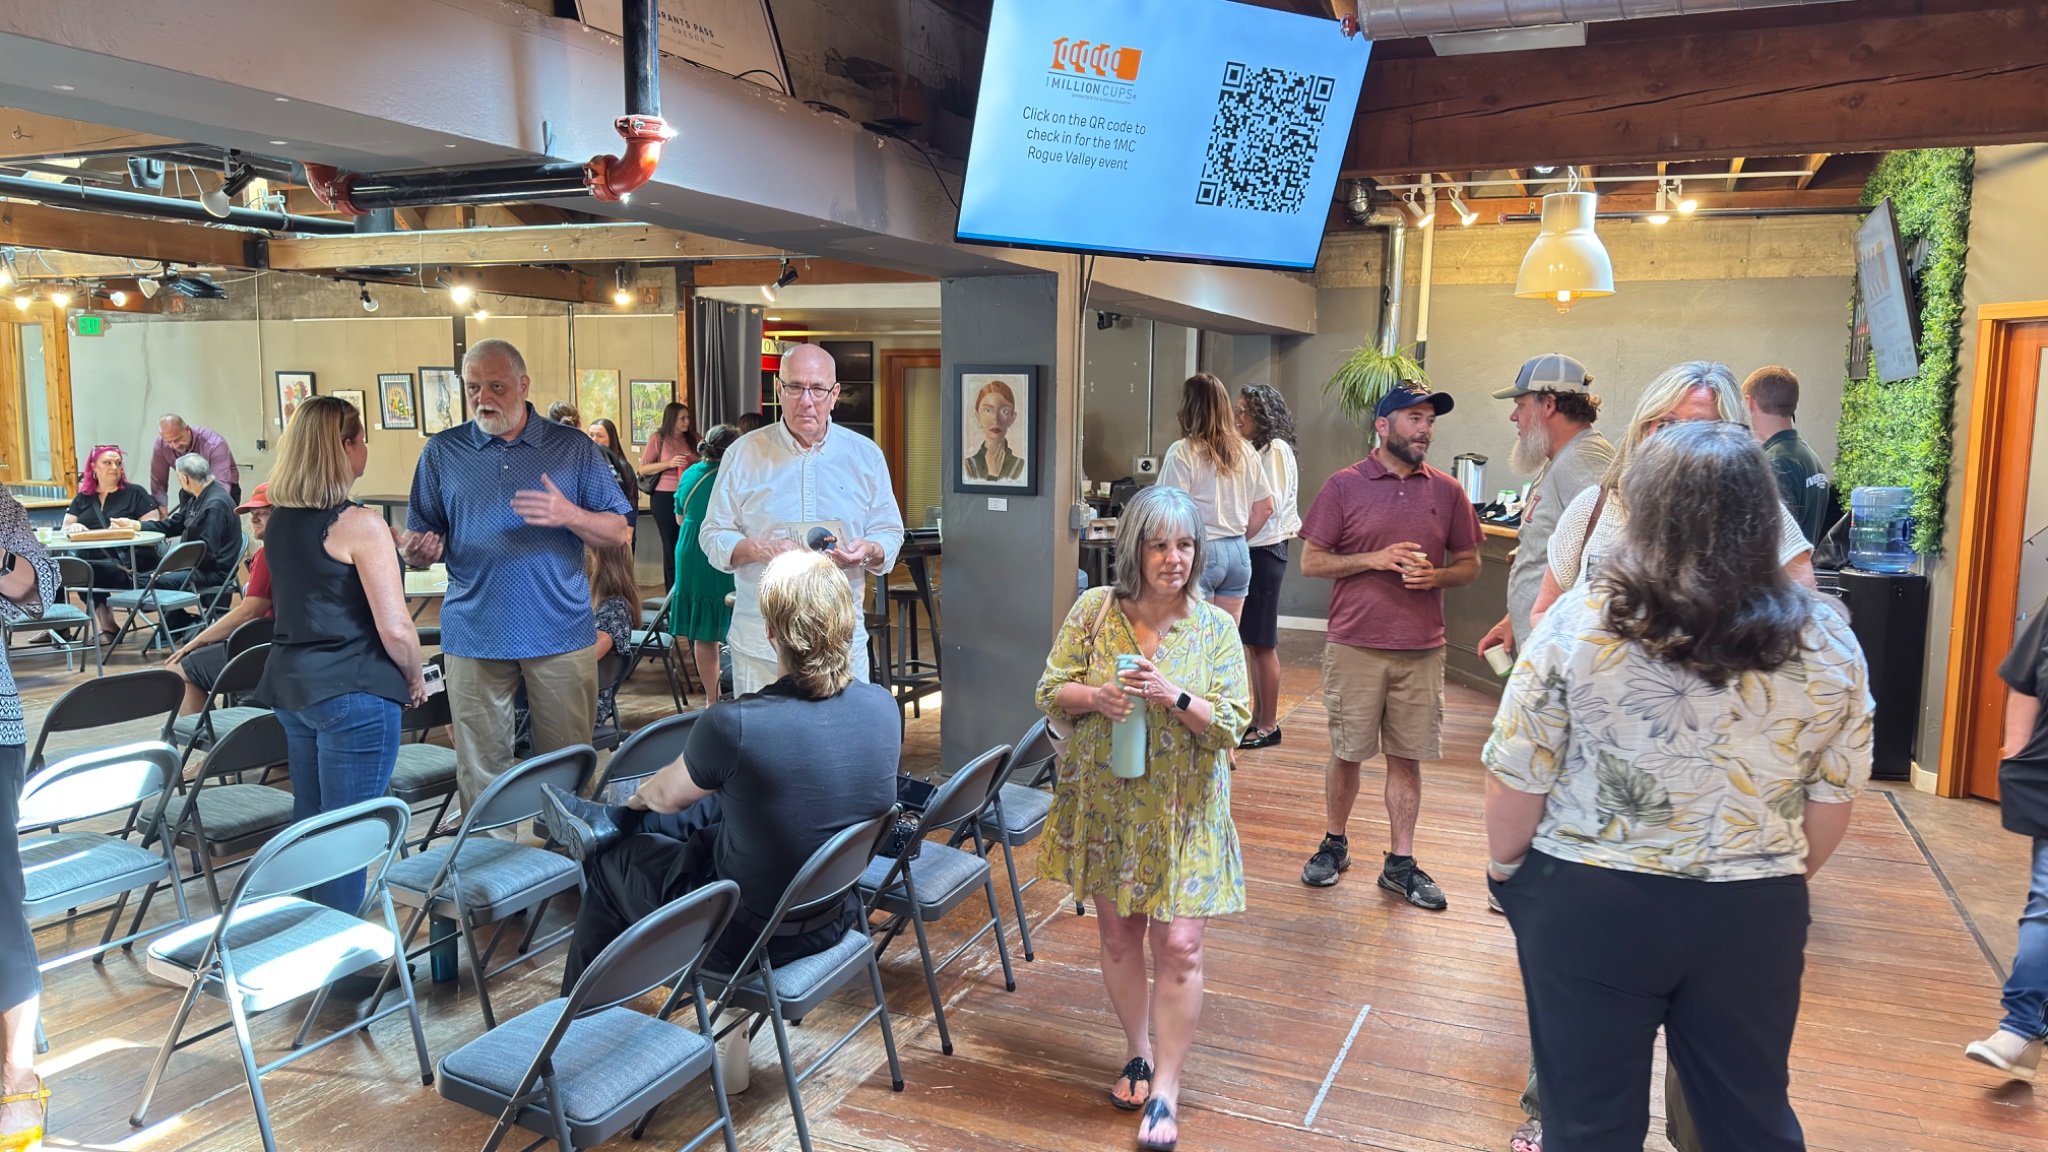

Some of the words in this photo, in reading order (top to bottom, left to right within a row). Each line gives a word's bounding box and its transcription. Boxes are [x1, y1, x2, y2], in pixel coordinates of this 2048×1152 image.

[671, 26, 705, 43] OREGON
[693, 23, 714, 38] PASS
[1051, 77, 1101, 95] MILLION
[1022, 106, 1051, 122] Click
[1051, 113, 1066, 124] on
[1068, 113, 1087, 127] the
[1089, 115, 1106, 130] QR
[1106, 120, 1133, 134] code
[1135, 123, 1146, 135] to
[1026, 127, 1060, 143] check
[1061, 131, 1072, 144] in
[1074, 133, 1091, 146] for
[1093, 135, 1111, 150] the
[1113, 138, 1136, 153] 1MC
[1027, 145, 1063, 164] Rogue
[1065, 150, 1097, 169] Valley
[1098, 157, 1128, 171] event
[79, 316, 101, 335] EXIT
